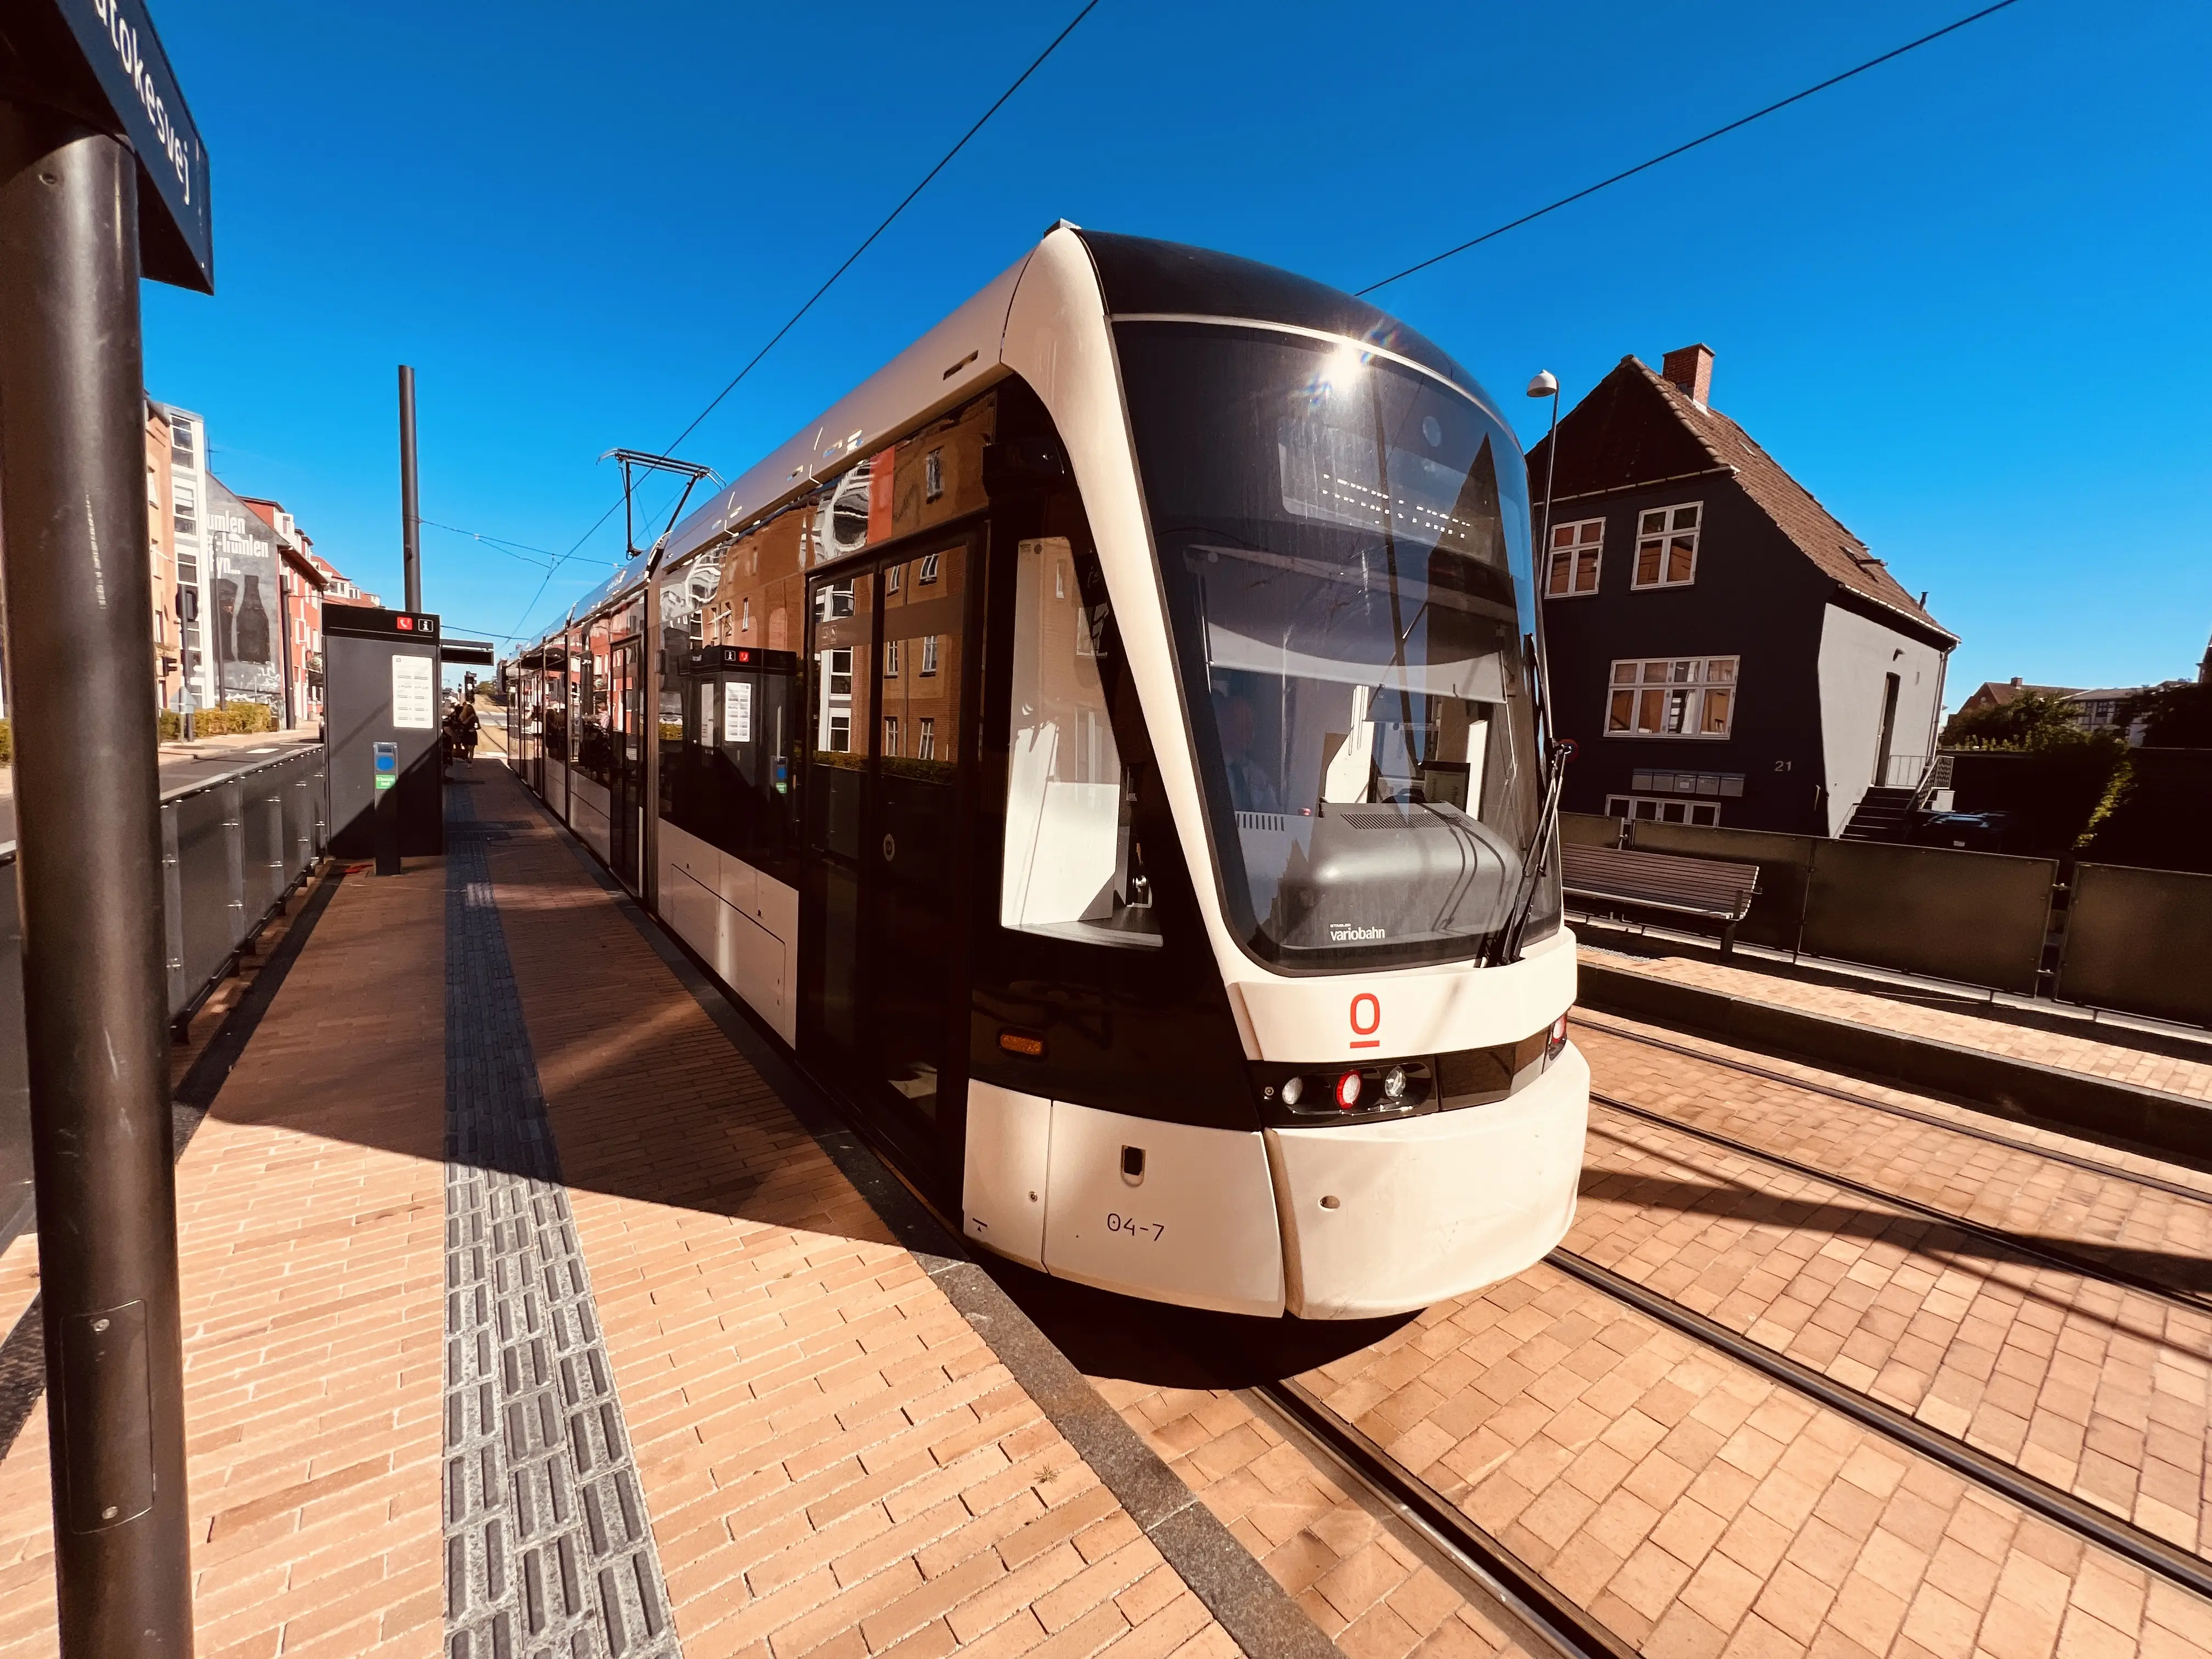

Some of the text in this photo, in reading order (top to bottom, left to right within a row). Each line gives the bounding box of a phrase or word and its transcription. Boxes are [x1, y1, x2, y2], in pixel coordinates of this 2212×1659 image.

[1775, 760, 1792, 772] 21
[1330, 926, 1385, 941] variobahn
[1107, 1213, 1165, 1241] 04-7
